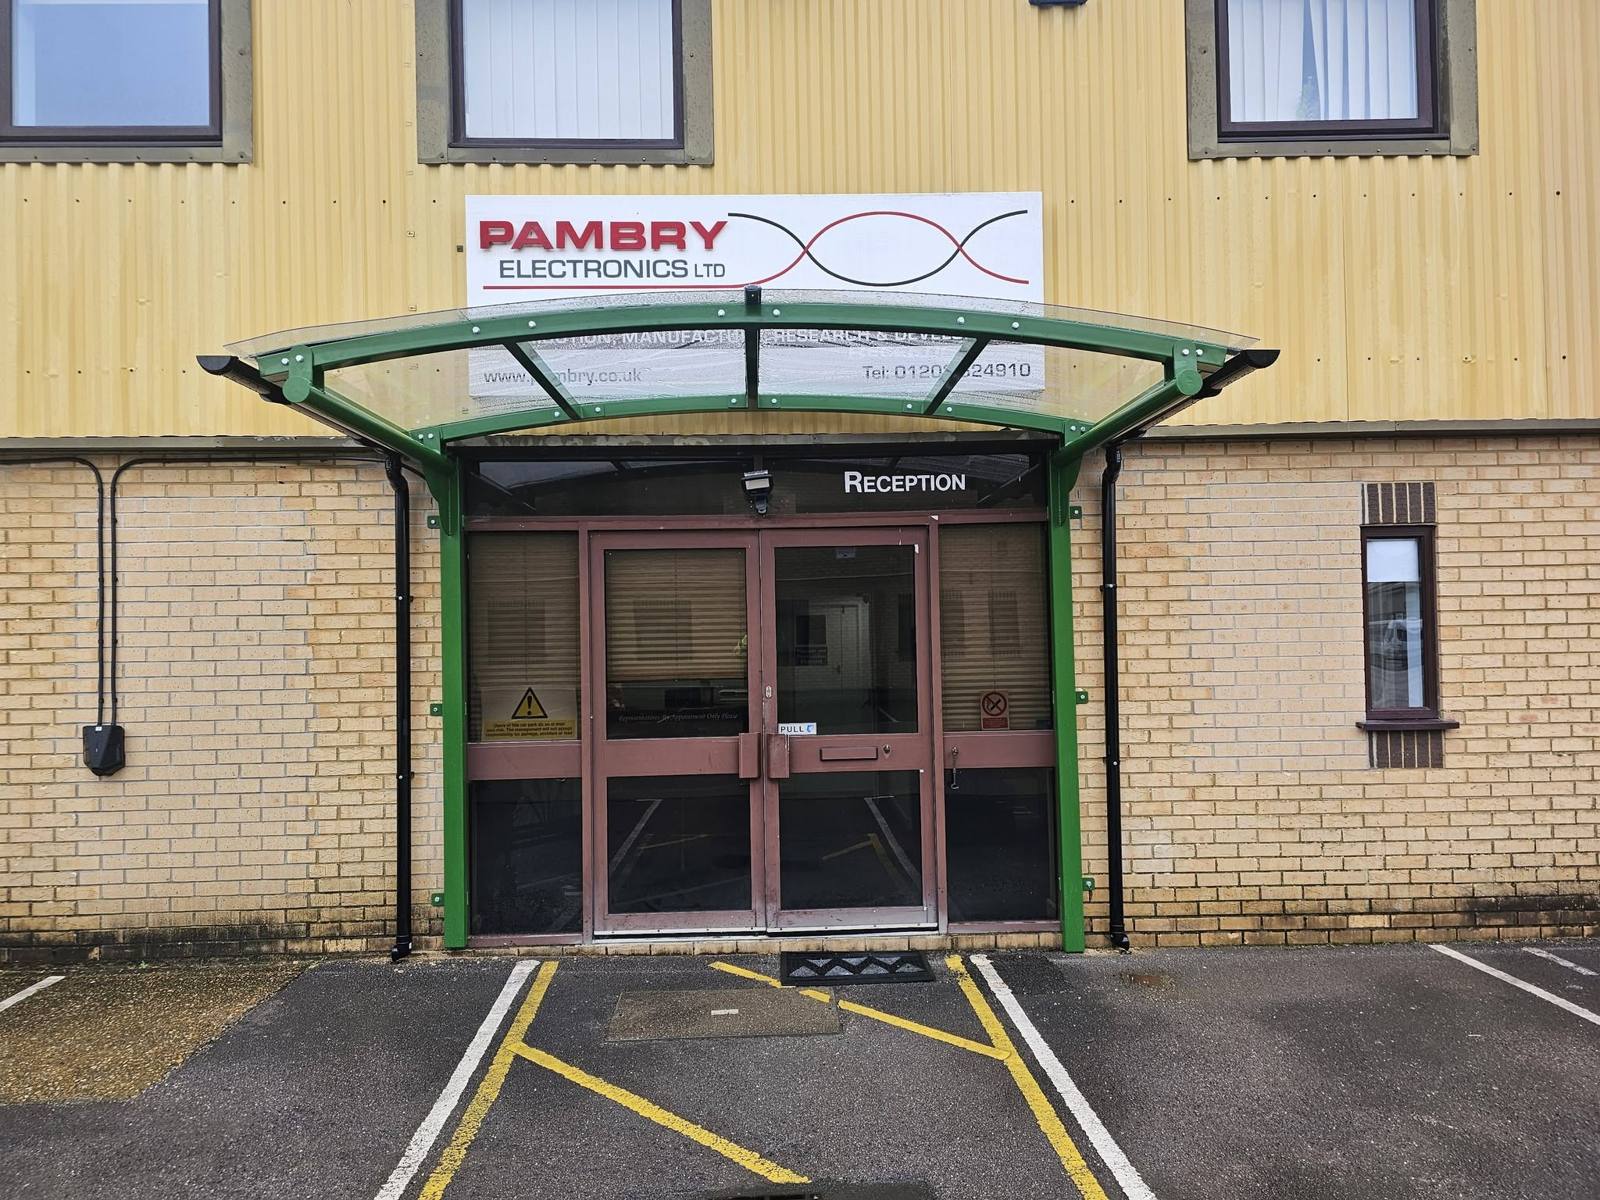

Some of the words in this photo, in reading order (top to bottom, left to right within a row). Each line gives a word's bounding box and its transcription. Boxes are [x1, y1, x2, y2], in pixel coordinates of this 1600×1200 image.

[480, 221, 728, 250] PAMBRY
[500, 260, 689, 278] ELECTRONICS
[694, 263, 726, 278] LTD
[862, 365, 889, 379] Tel:
[844, 471, 966, 493] RECEPTION
[780, 725, 804, 733] PULL
